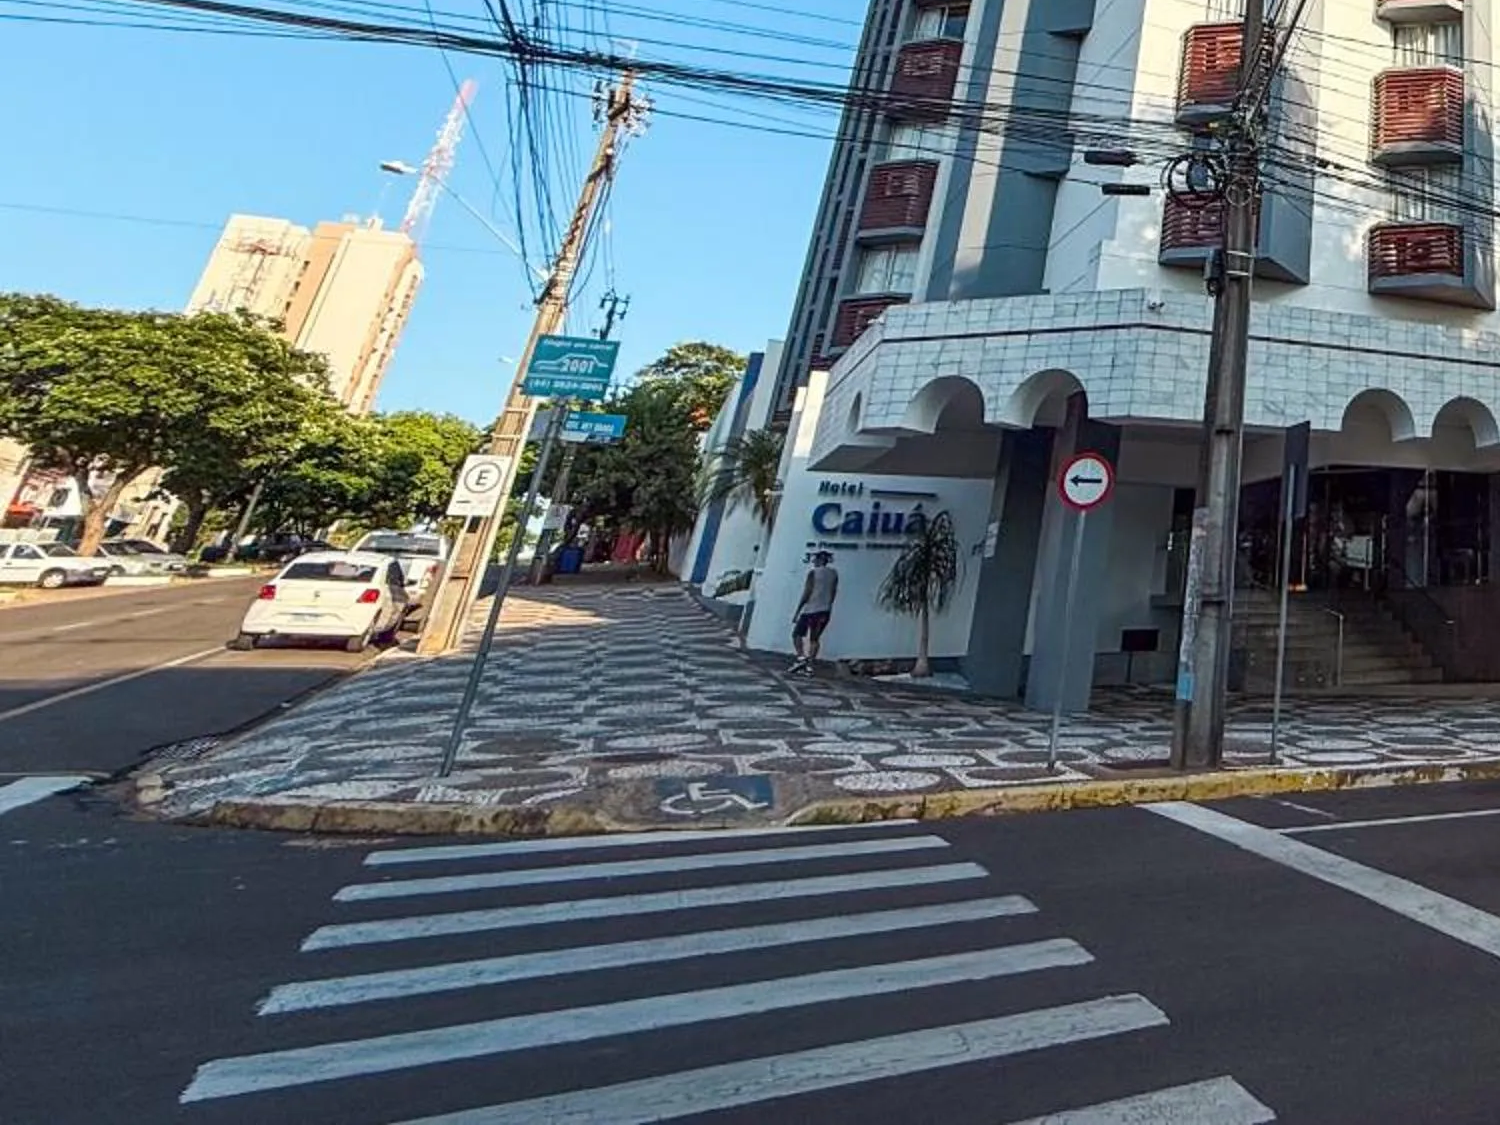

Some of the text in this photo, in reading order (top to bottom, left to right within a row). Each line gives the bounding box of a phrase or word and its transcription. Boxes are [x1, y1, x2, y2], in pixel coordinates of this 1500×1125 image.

[475, 468, 491, 486] E
[818, 480, 864, 496] Hotel
[812, 501, 928, 535] Caiuá
